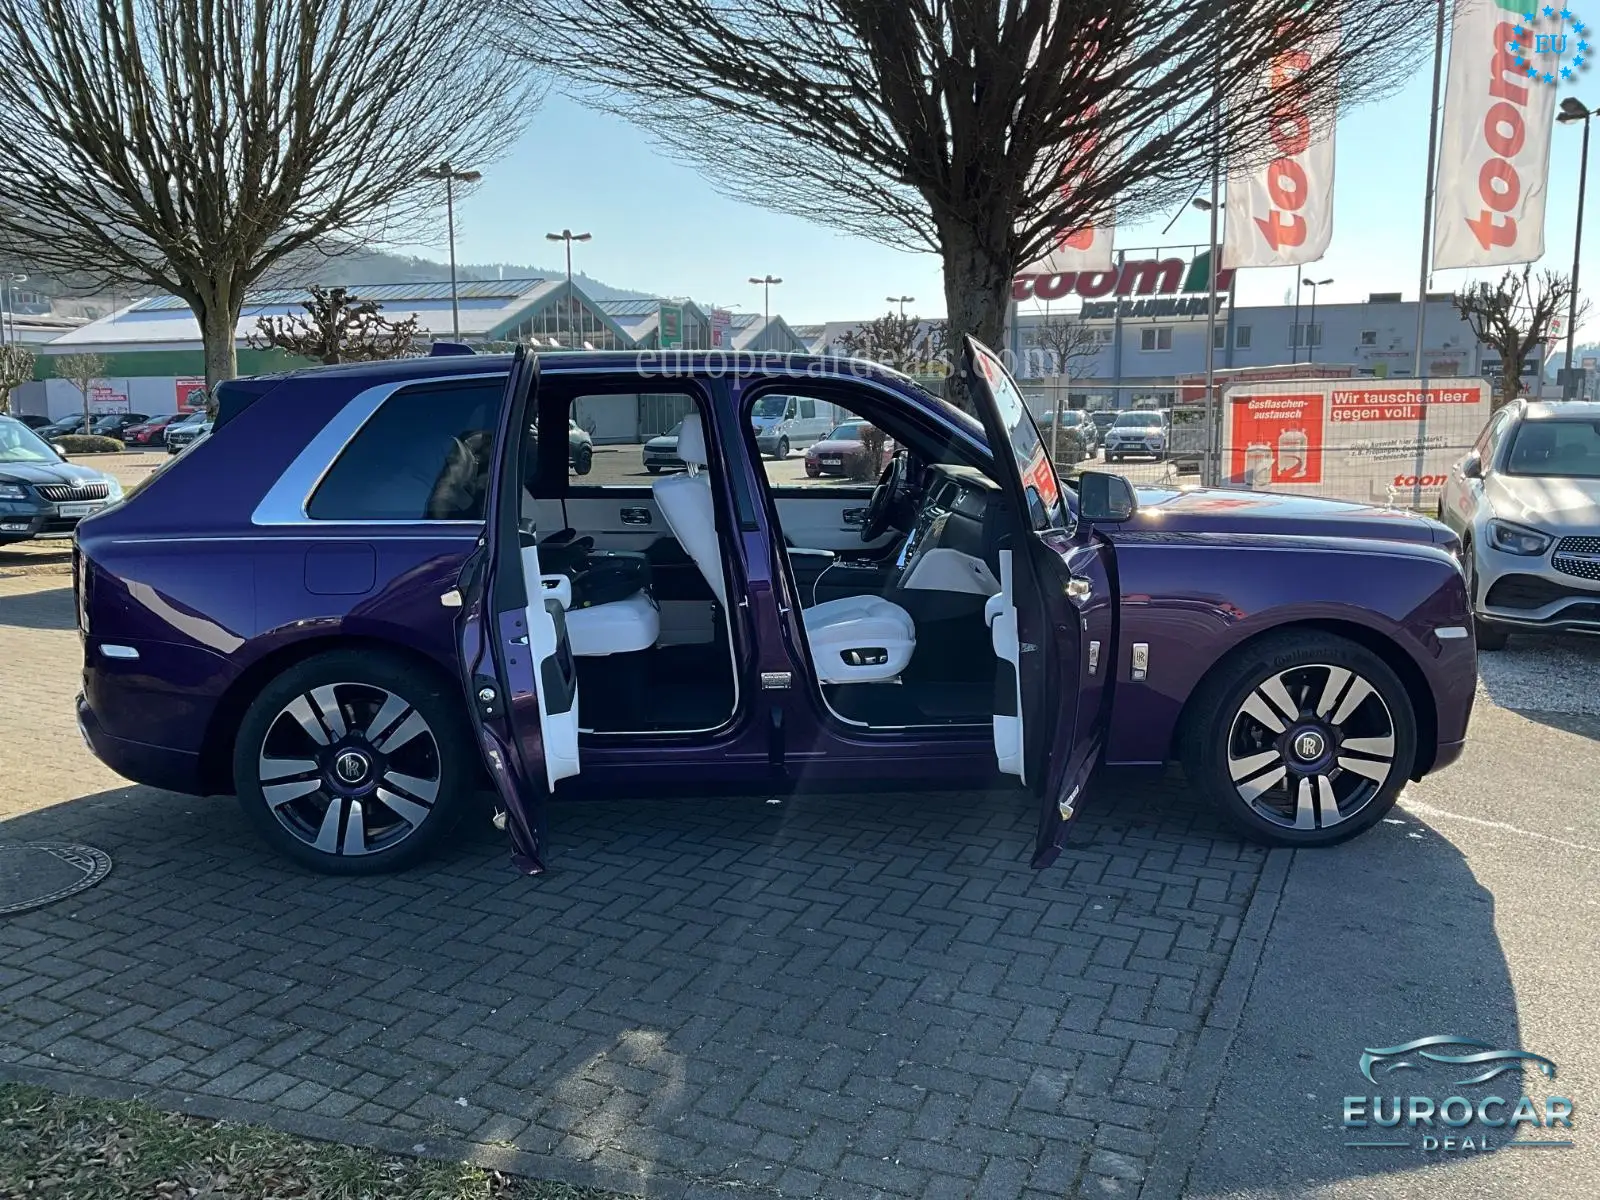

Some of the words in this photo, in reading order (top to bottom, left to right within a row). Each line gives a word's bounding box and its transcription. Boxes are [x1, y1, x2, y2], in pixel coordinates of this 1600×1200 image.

[1464, 21, 1534, 251] toom
[1334, 392, 1360, 404] Wir
[1363, 390, 1435, 404] tauschen
[1439, 389, 1470, 402] leer
[1247, 399, 1309, 410] Gasflaschen-
[1253, 410, 1303, 420] austausch
[1333, 408, 1380, 422] gegen
[1384, 405, 1416, 418] voll.
